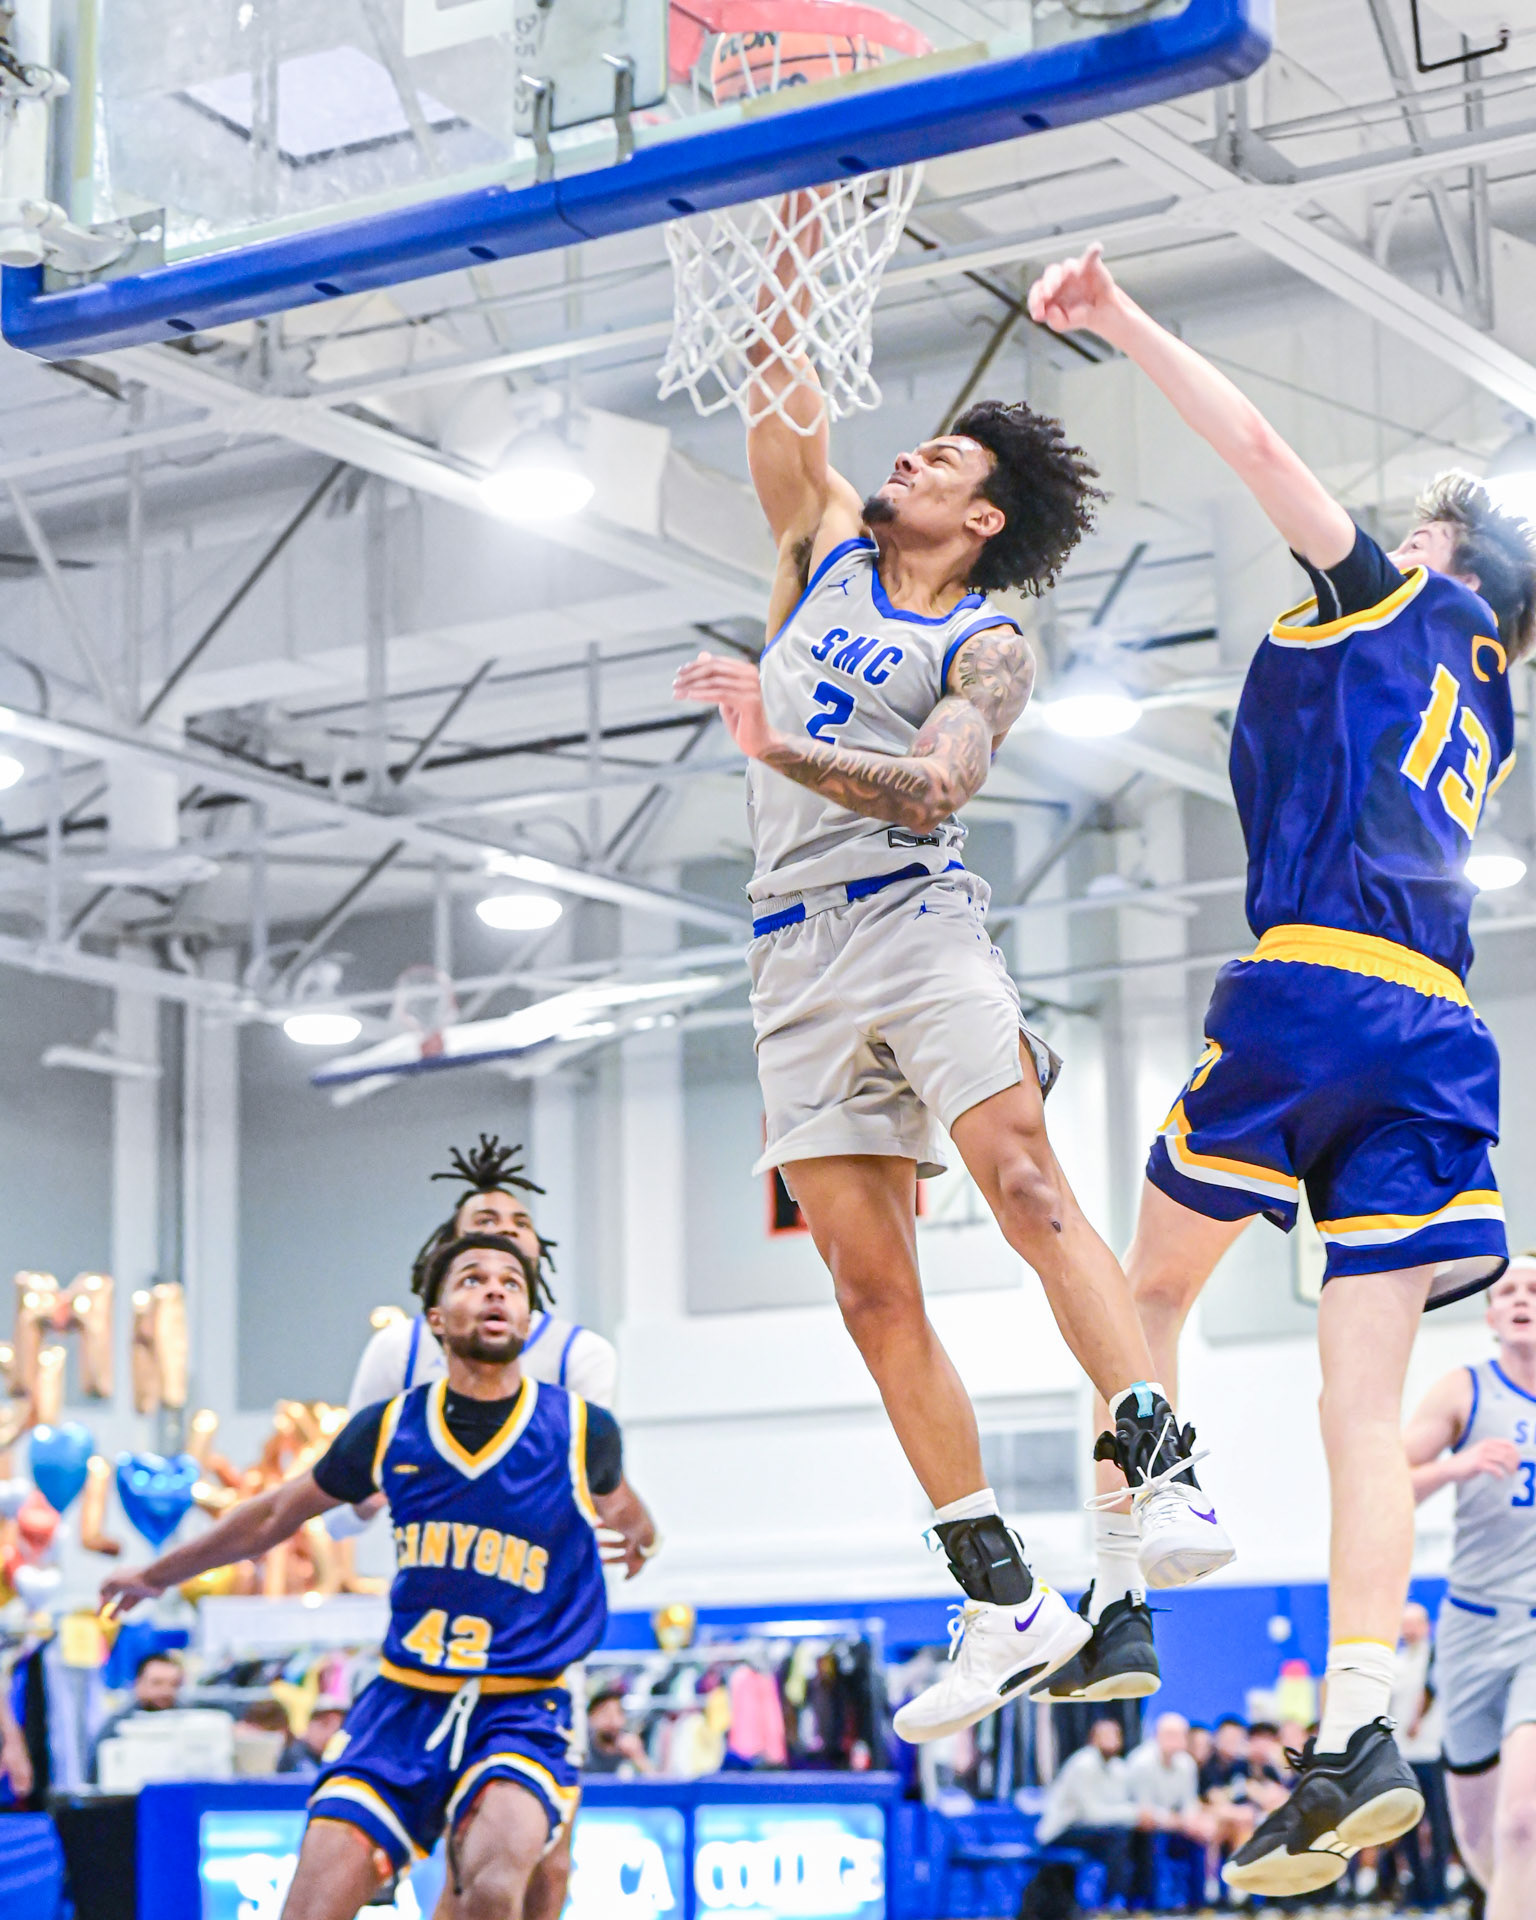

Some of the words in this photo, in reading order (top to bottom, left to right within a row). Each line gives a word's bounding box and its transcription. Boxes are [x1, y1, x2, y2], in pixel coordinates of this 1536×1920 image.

[810, 627, 904, 686] SMC
[805, 680, 856, 746] 2
[1400, 662, 1493, 841] 13
[1514, 1419, 1536, 1444] S
[402, 1608, 494, 1670] 42
